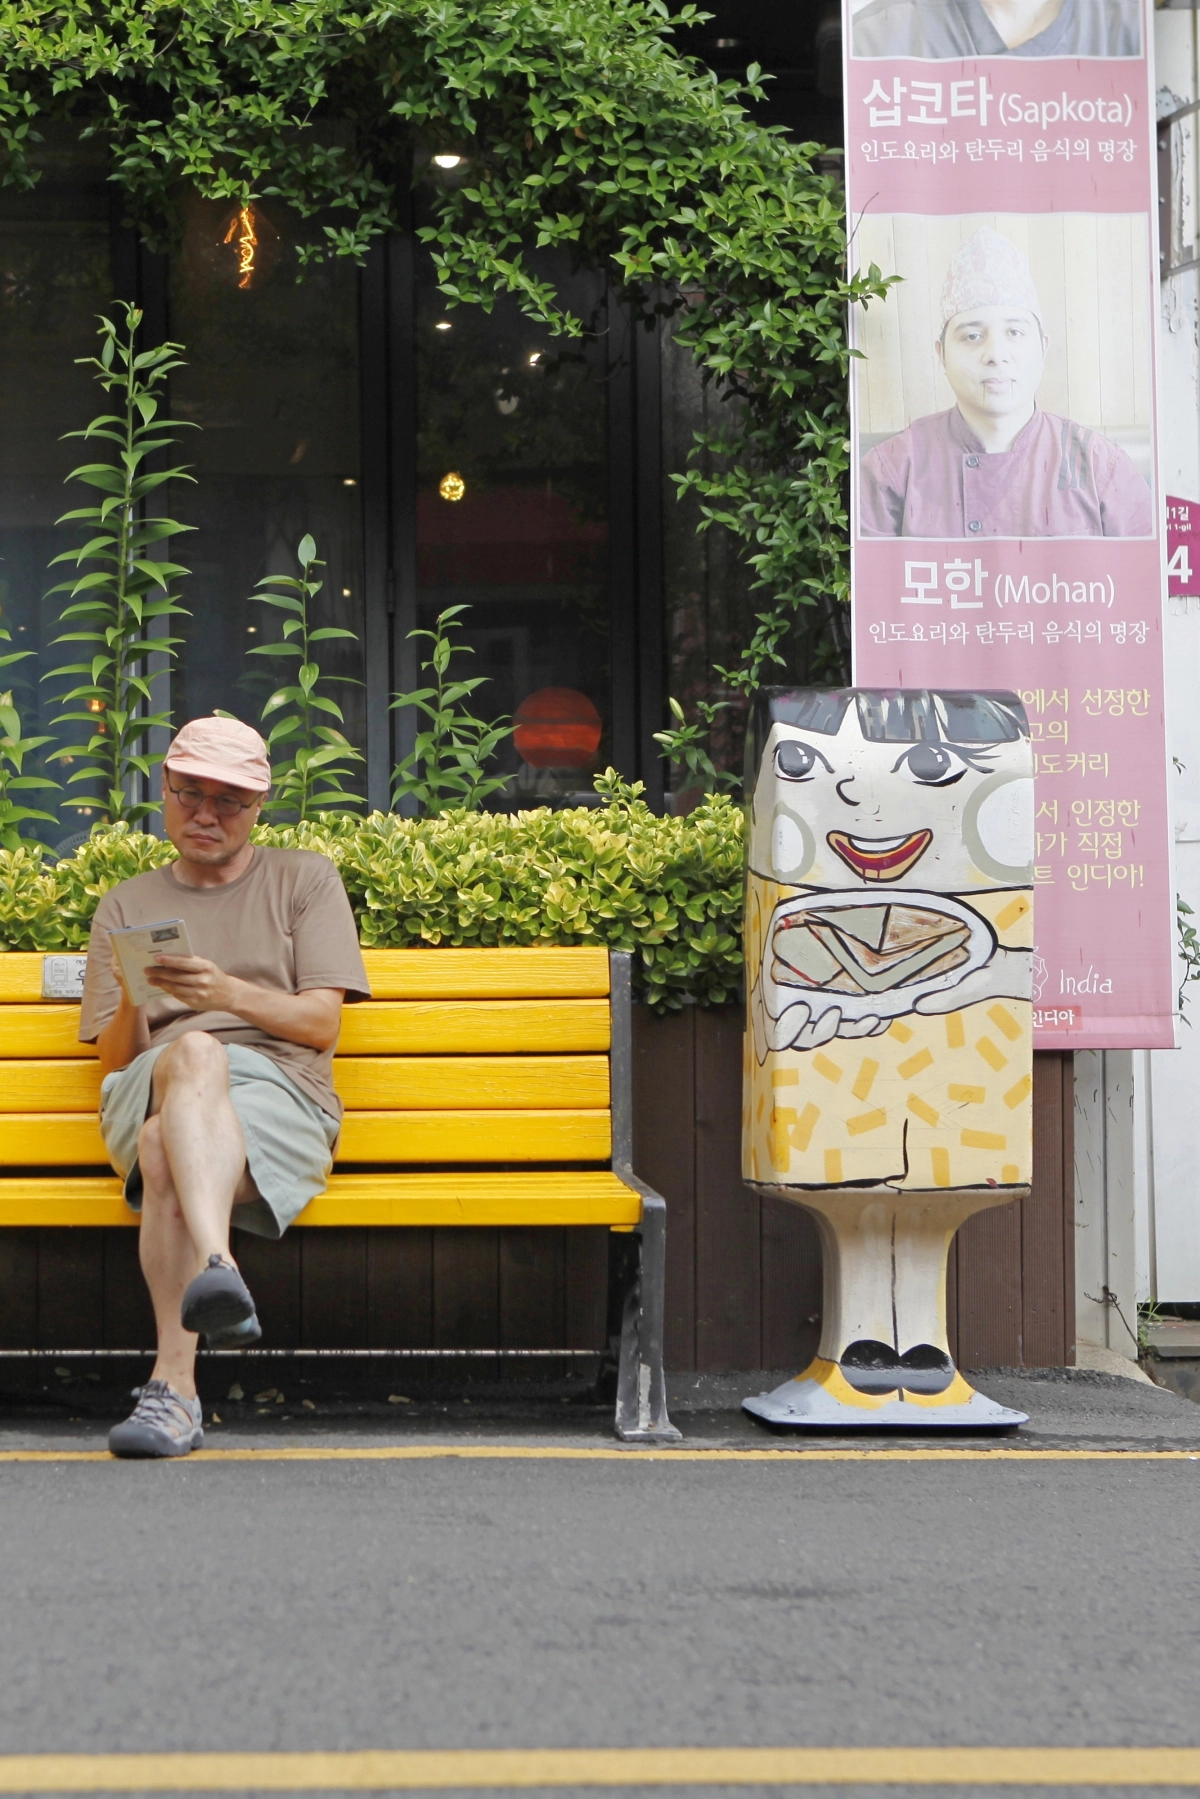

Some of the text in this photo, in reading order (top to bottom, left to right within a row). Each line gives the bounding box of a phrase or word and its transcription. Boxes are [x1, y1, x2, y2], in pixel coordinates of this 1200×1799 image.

[863, 77, 1132, 129] 삽코타 (Sapkota)
[861, 138, 1137, 164] 인도요리와 탄두리 음식의 명장
[1174, 523, 1192, 532] 1-gil
[901, 559, 1115, 609] 모한 (Mohan)
[869, 620, 1150, 645] 인도요리와 탄두리 음식의 명장
[1081, 688, 1151, 717] 선정한
[1035, 799, 1141, 827] 서 인정한
[1078, 832, 1122, 860] 직접
[1067, 864, 1144, 891] 인디아!
[1060, 965, 1113, 996] India
